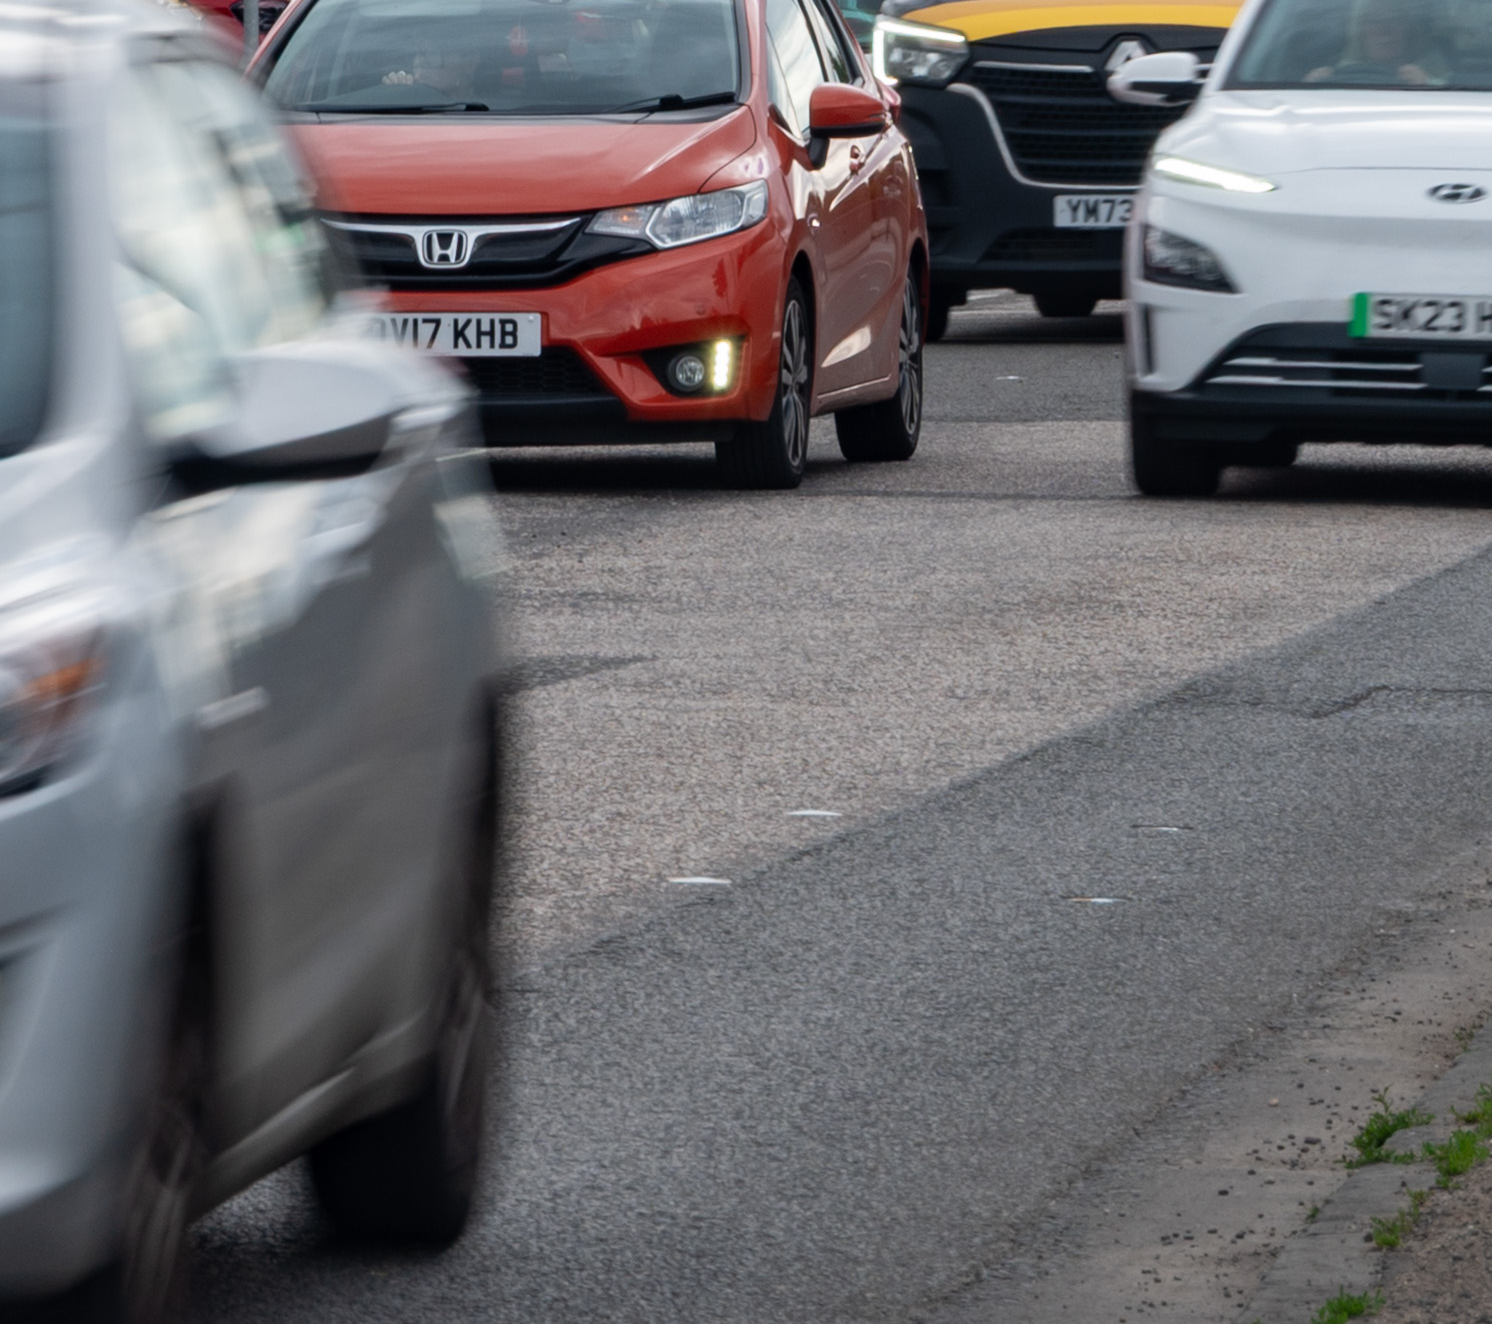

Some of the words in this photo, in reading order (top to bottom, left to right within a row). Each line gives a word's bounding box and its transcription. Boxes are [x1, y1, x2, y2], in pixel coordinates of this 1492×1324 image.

[1066, 197, 1134, 223] YM73
[1374, 299, 1466, 332] SK23
[453, 318, 519, 349] KHB
